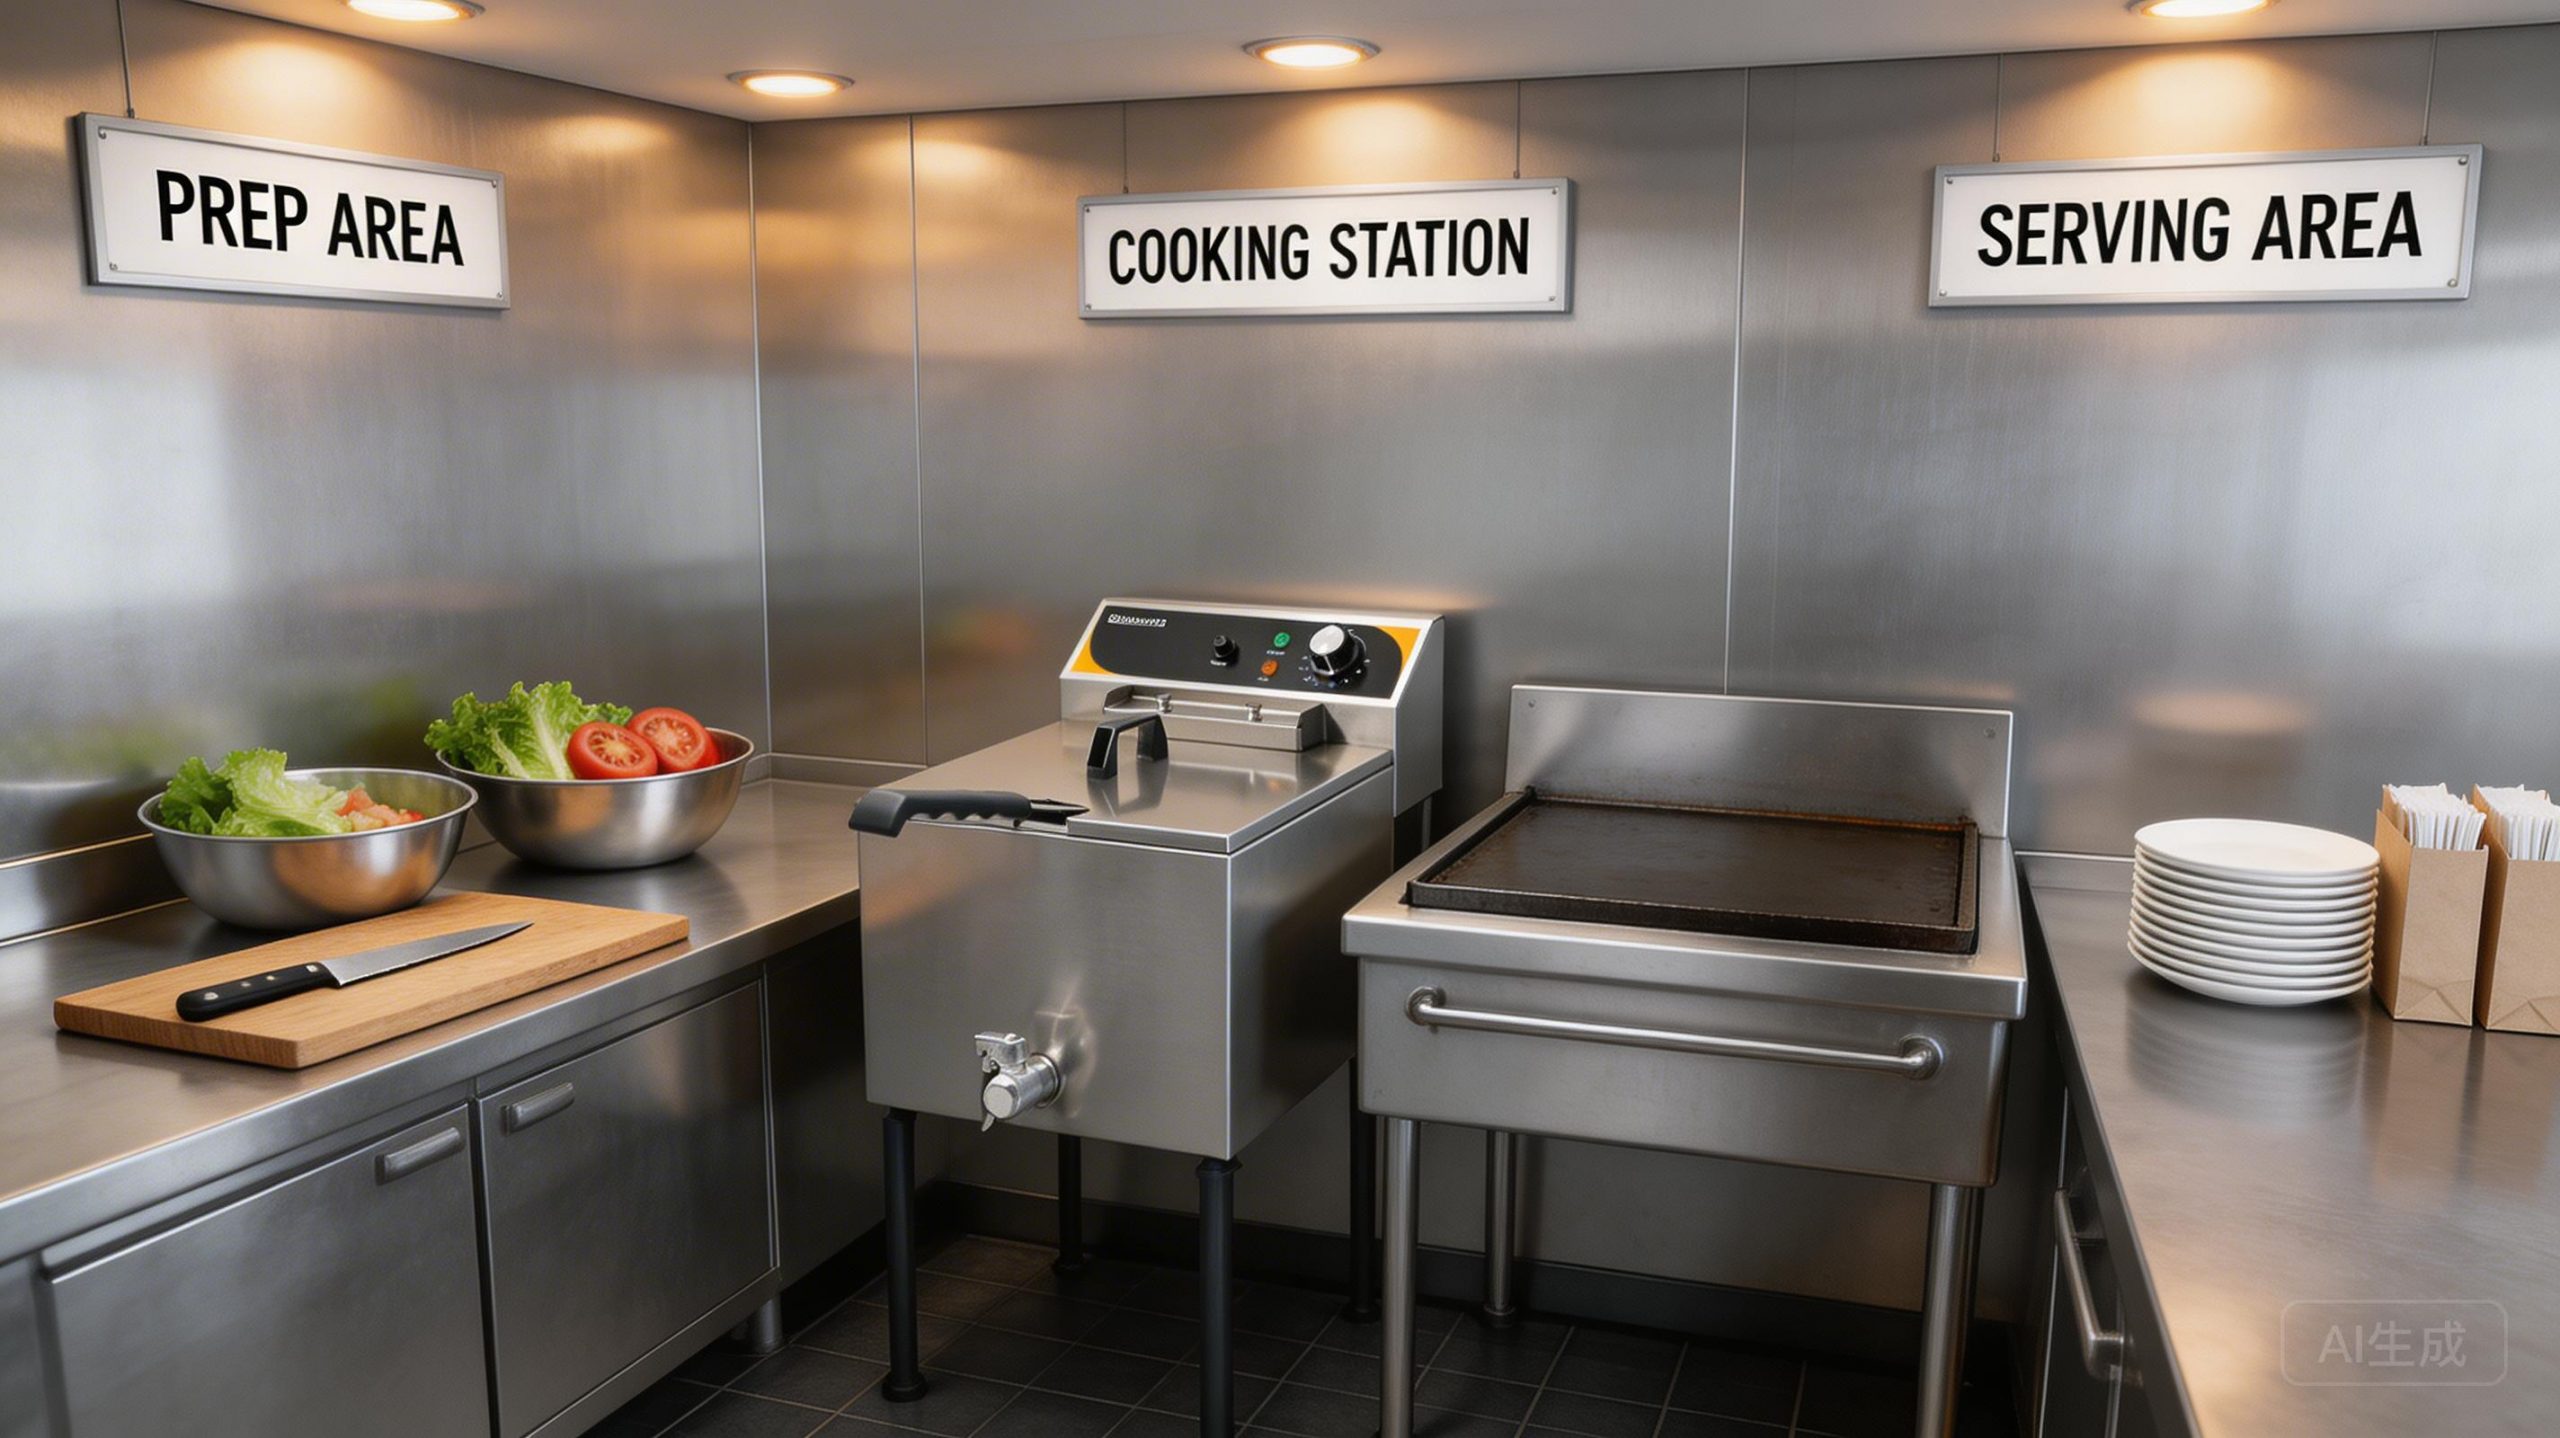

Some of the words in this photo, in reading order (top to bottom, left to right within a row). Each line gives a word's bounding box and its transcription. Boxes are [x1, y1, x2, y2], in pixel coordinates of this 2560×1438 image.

[156, 169, 309, 252] PREP
[327, 192, 465, 267] AREA
[1109, 223, 1310, 286] COOKING
[1329, 217, 1530, 280] STATION
[1977, 197, 2230, 267] SERVING
[2251, 190, 2422, 261] AREA
